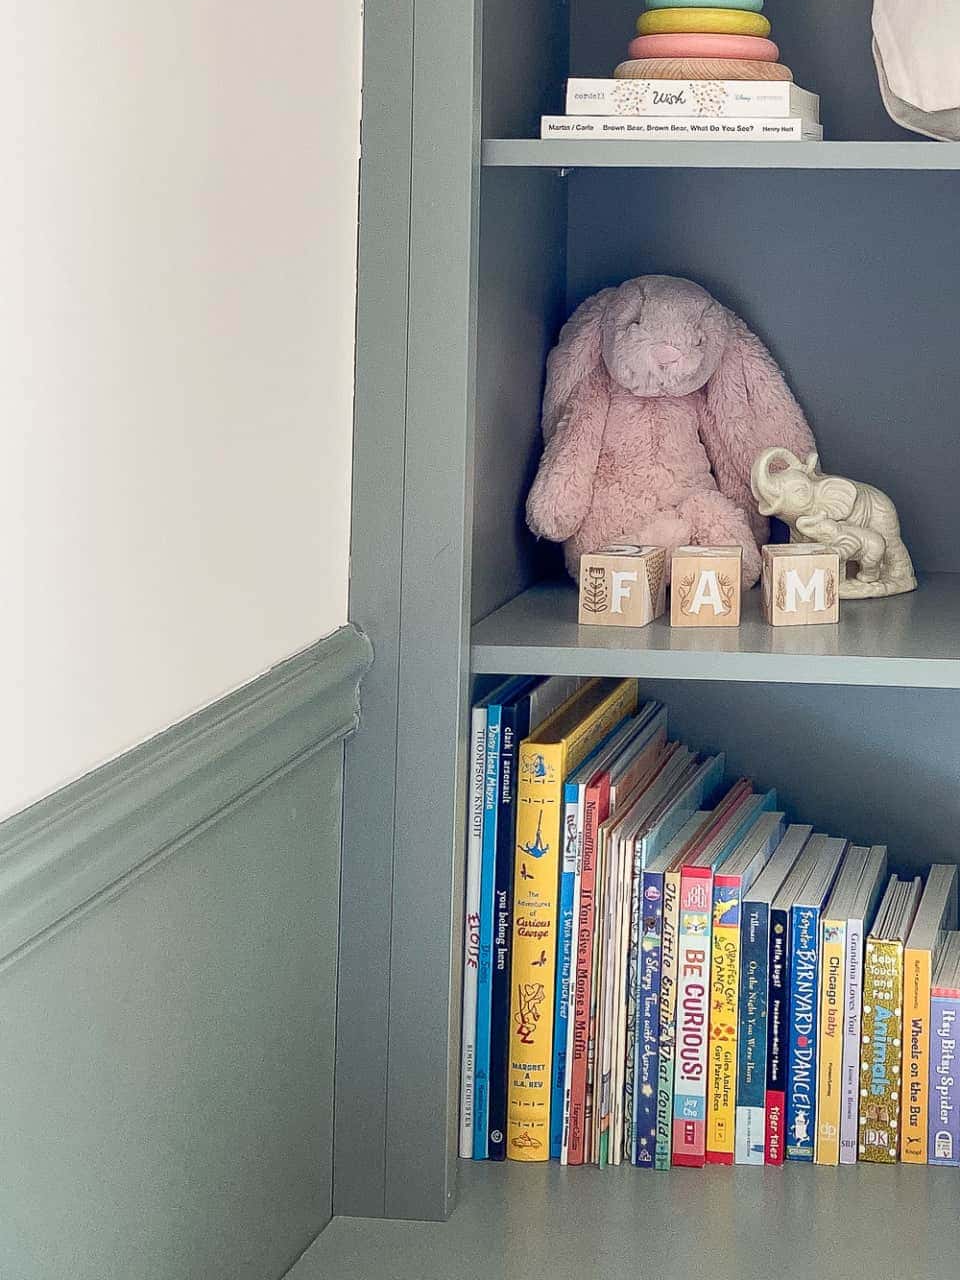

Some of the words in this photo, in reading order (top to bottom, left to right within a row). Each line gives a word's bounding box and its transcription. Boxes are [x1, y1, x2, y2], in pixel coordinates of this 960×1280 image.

[652, 90, 686, 104] Wish
[626, 124, 645, 132] Bear,
[646, 124, 668, 132] Brown
[670, 124, 688, 132] Bear,
[610, 570, 637, 614] F
[688, 570, 726, 615] A
[784, 570, 826, 612] M
[503, 727, 513, 749] clark
[488, 752, 498, 775] Head
[502, 760, 512, 804] arsenault
[496, 890, 506, 908] you
[582, 888, 592, 898] If
[664, 883, 676, 912] The
[516, 917, 550, 928] Curious
[580, 902, 592, 924] You
[496, 912, 508, 944] belong
[518, 928, 549, 940] George
[564, 920, 572, 938] Wish
[750, 912, 759, 942] Tillman
[466, 912, 480, 968] ELOISE
[579, 929, 590, 954] Give
[664, 917, 676, 968] Little
[774, 938, 782, 962] Hello,
[684, 950, 706, 978] BE
[748, 961, 758, 974] On
[850, 933, 859, 980] Grandma
[871, 954, 896, 965] Baby
[642, 958, 658, 990] Sleepy
[714, 956, 725, 994] DANCE
[772, 964, 782, 988] Bugs!
[826, 956, 840, 1004] Chicago
[869, 966, 898, 976] Touch
[576, 968, 588, 1006] Moose
[749, 976, 758, 990] the
[794, 950, 817, 1035] BARNYARD
[874, 980, 893, 988] and
[748, 992, 758, 1014] Night
[850, 982, 858, 1010] Loves
[872, 990, 894, 1000] Feel
[560, 1001, 569, 1020] Feet
[644, 1020, 656, 1042] with
[680, 984, 704, 1080] CURIOUS!
[748, 1018, 756, 1035] You
[826, 1008, 838, 1038] baby
[848, 1015, 857, 1036] You!
[574, 1020, 588, 1060] Muffin
[748, 1038, 756, 1060] Were
[870, 1005, 894, 1096] Animals
[912, 1018, 922, 1060] Wheels
[660, 1046, 671, 1083] That
[713, 1046, 722, 1062] Guy
[723, 1052, 731, 1071] Giles
[746, 1062, 754, 1083] Born
[792, 1048, 813, 1108] DANCE!
[911, 1062, 920, 1078] on
[713, 1064, 722, 1112] Parker-Rees
[911, 1082, 921, 1102] the
[684, 1107, 698, 1116] Cho
[936, 1077, 954, 1124] Spider
[658, 1090, 670, 1138] Could
[770, 1106, 780, 1132] tiger
[910, 1106, 921, 1127] Bus
[770, 1134, 780, 1160] tales
[867, 1131, 888, 1146] DK
